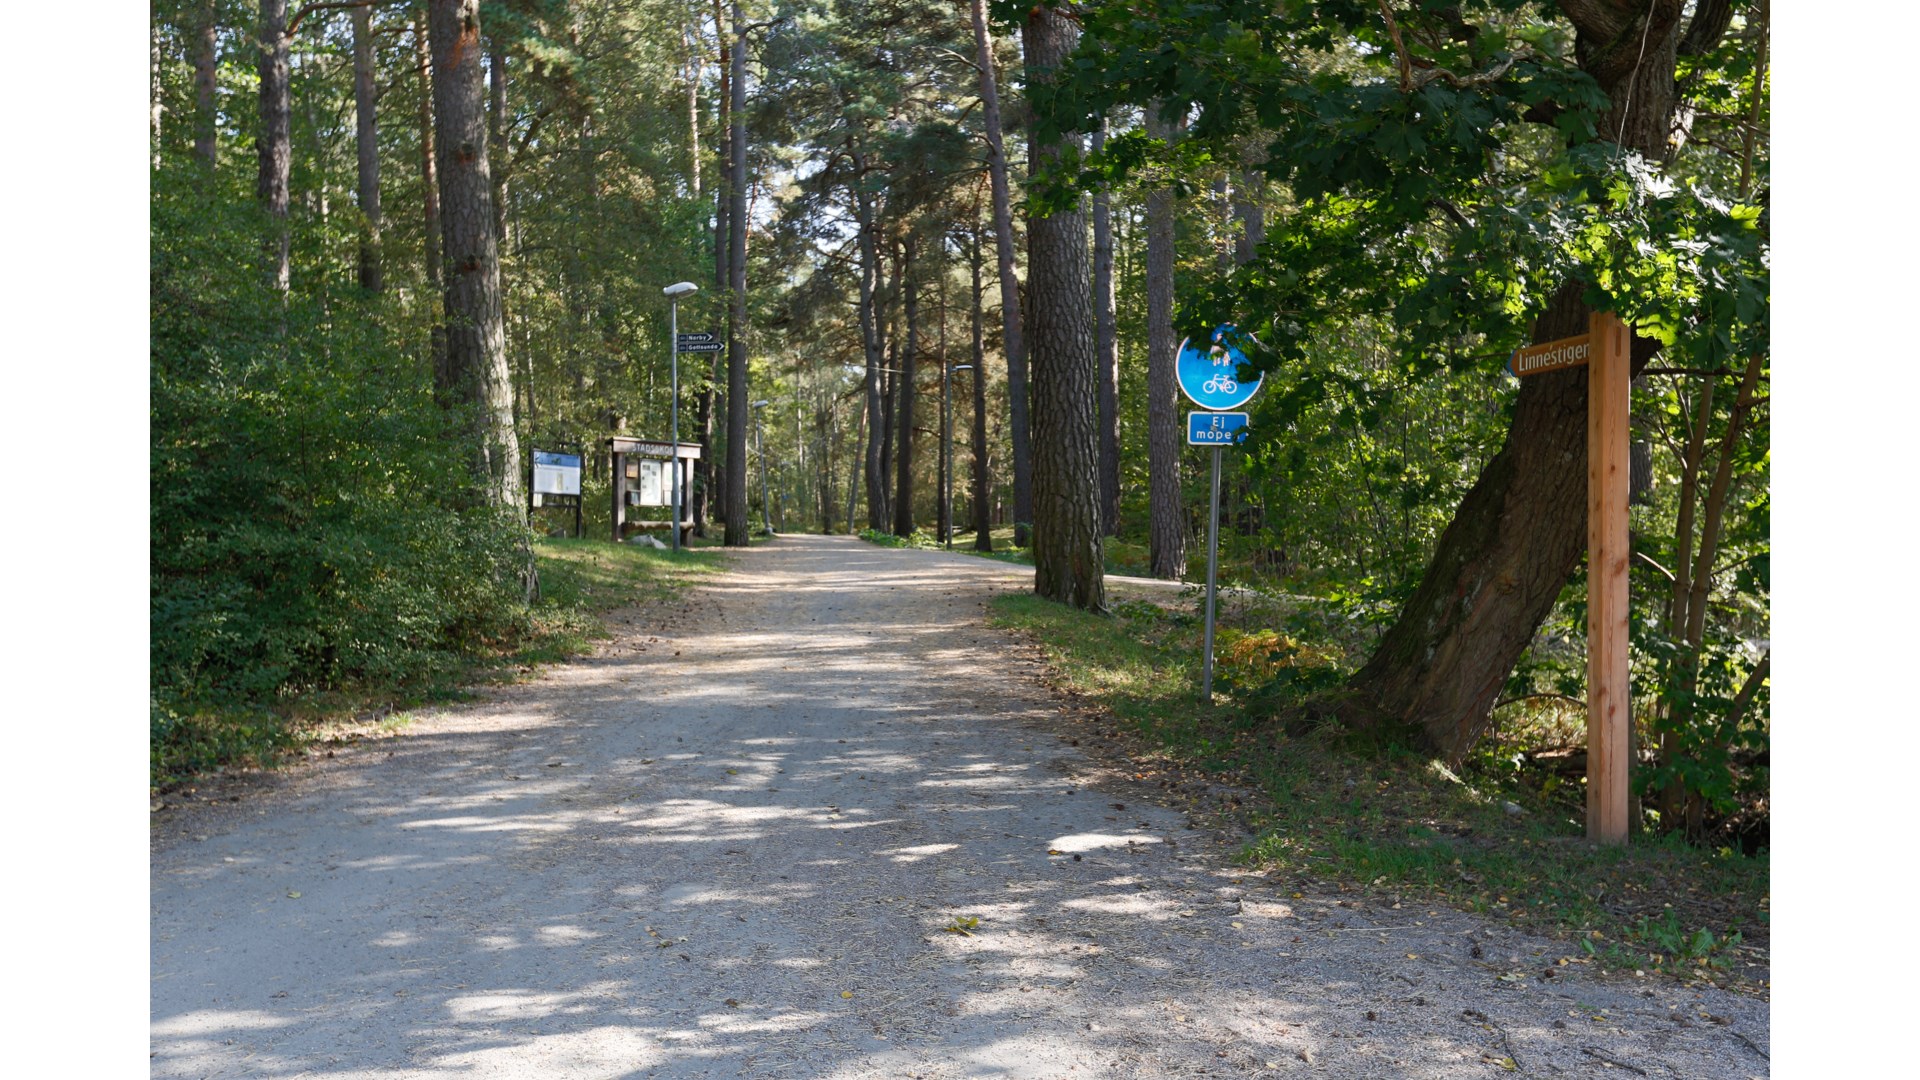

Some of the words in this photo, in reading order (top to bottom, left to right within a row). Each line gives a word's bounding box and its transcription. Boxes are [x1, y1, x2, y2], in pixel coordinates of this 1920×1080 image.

[1519, 343, 1589, 372] Linnéstigen
[1212, 416, 1225, 429] Ej
[1196, 430, 1240, 441] mope
